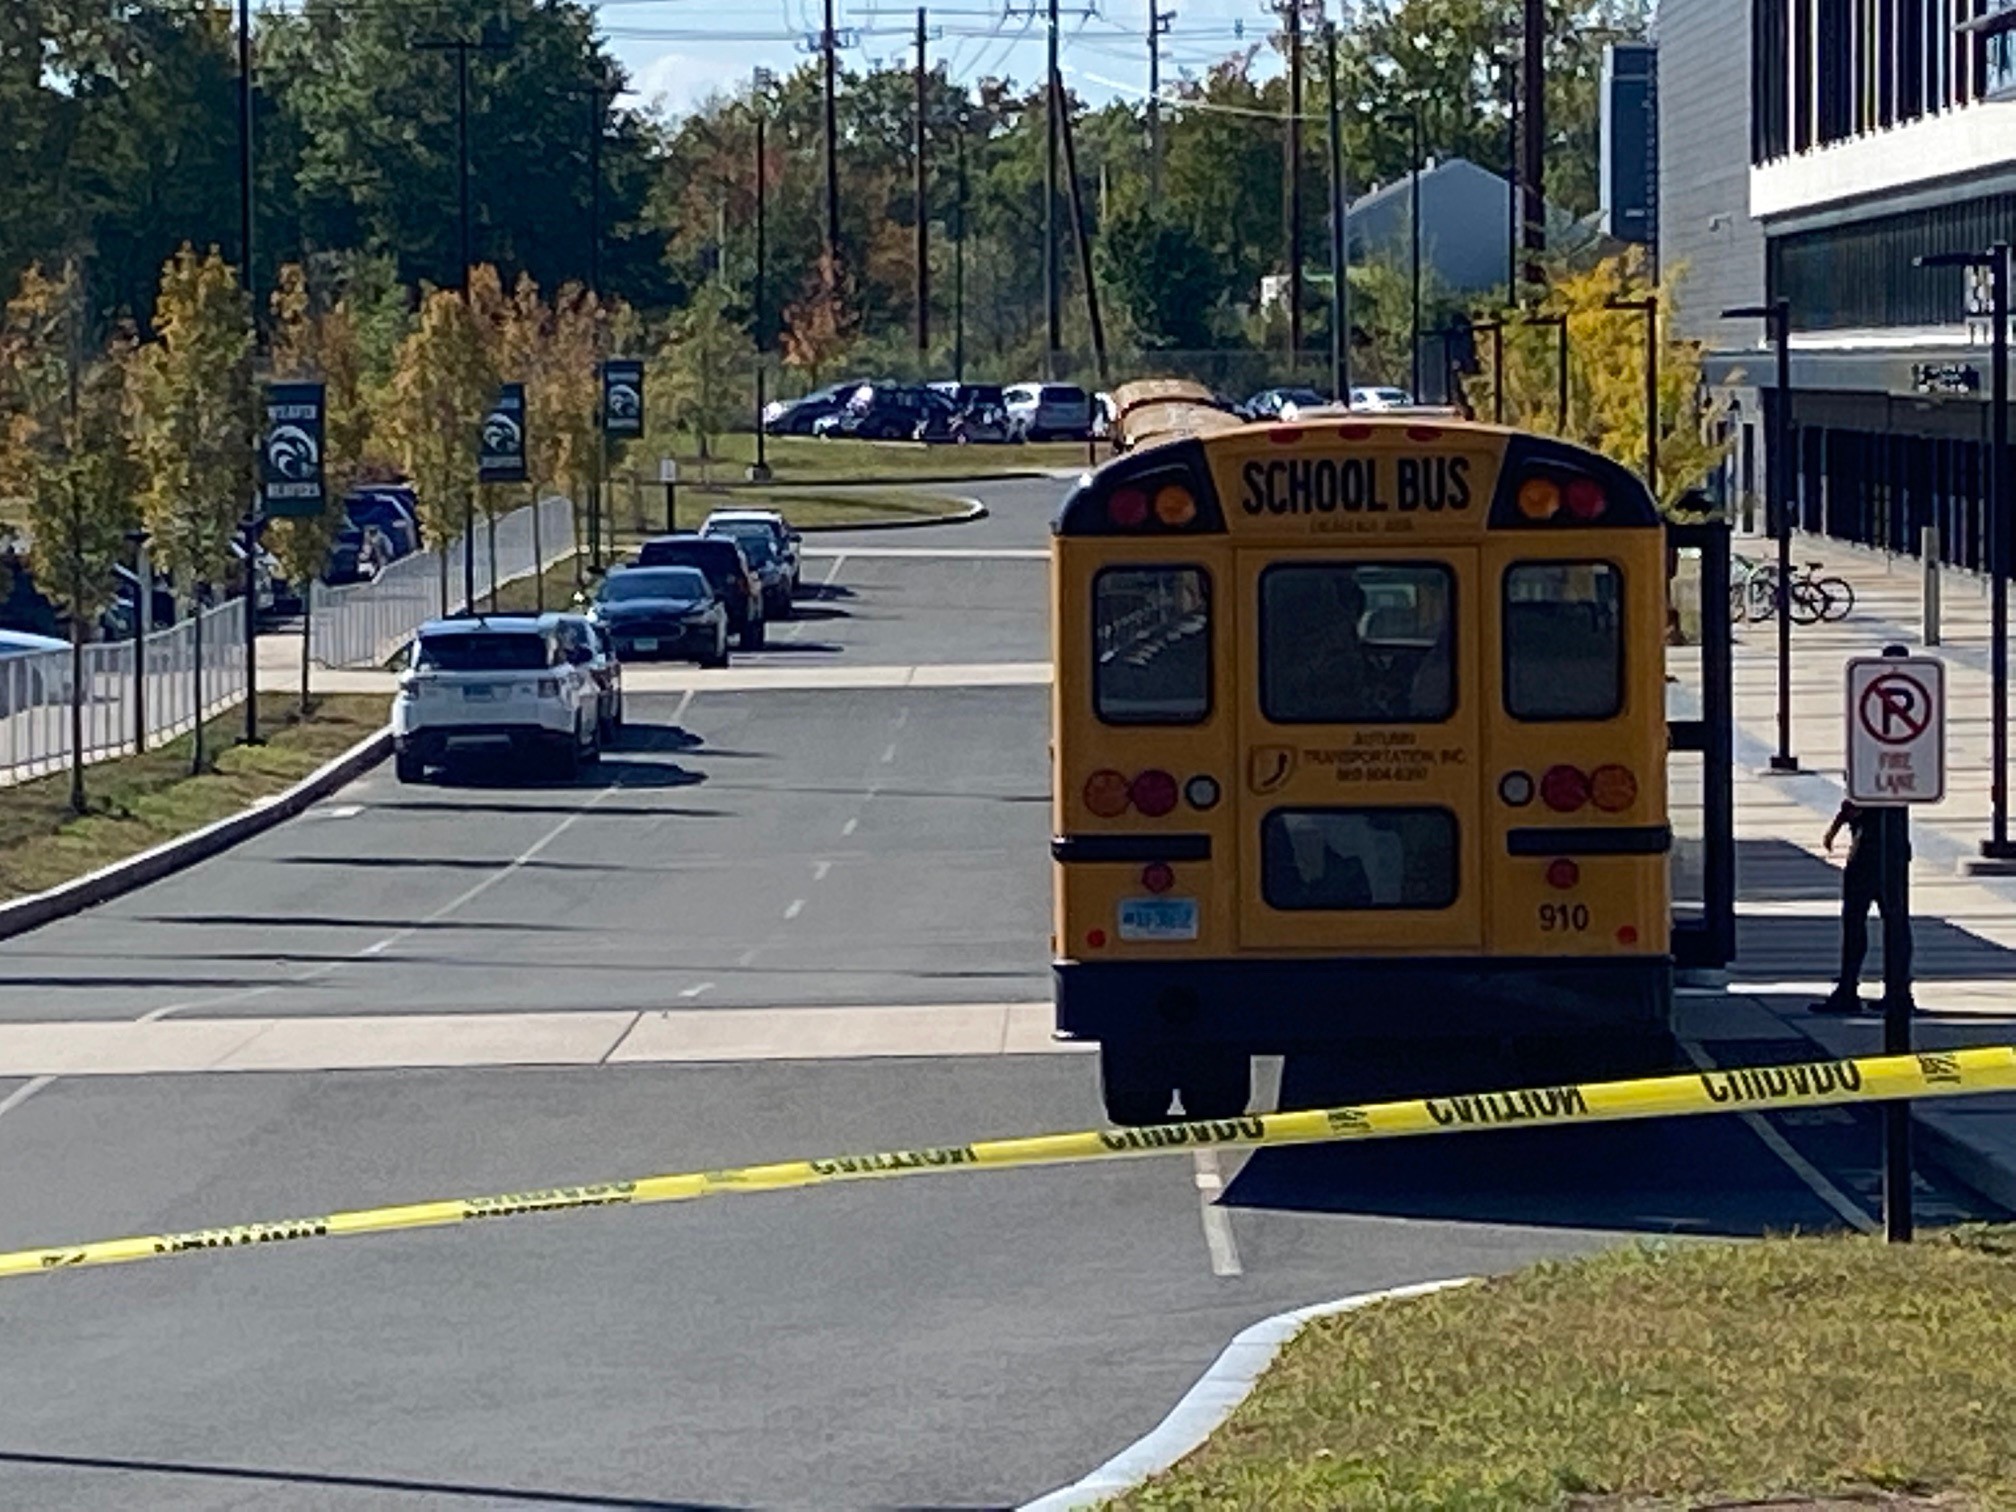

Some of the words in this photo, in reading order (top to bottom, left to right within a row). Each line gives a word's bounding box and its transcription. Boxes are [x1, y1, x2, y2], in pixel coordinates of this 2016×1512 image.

[1242, 458, 1389, 515] SCHOOL
[1397, 456, 1471, 512] BUS
[1879, 752, 1912, 770] FIRE
[1875, 772, 1916, 793] LANE
[1538, 903, 1590, 932] 910
